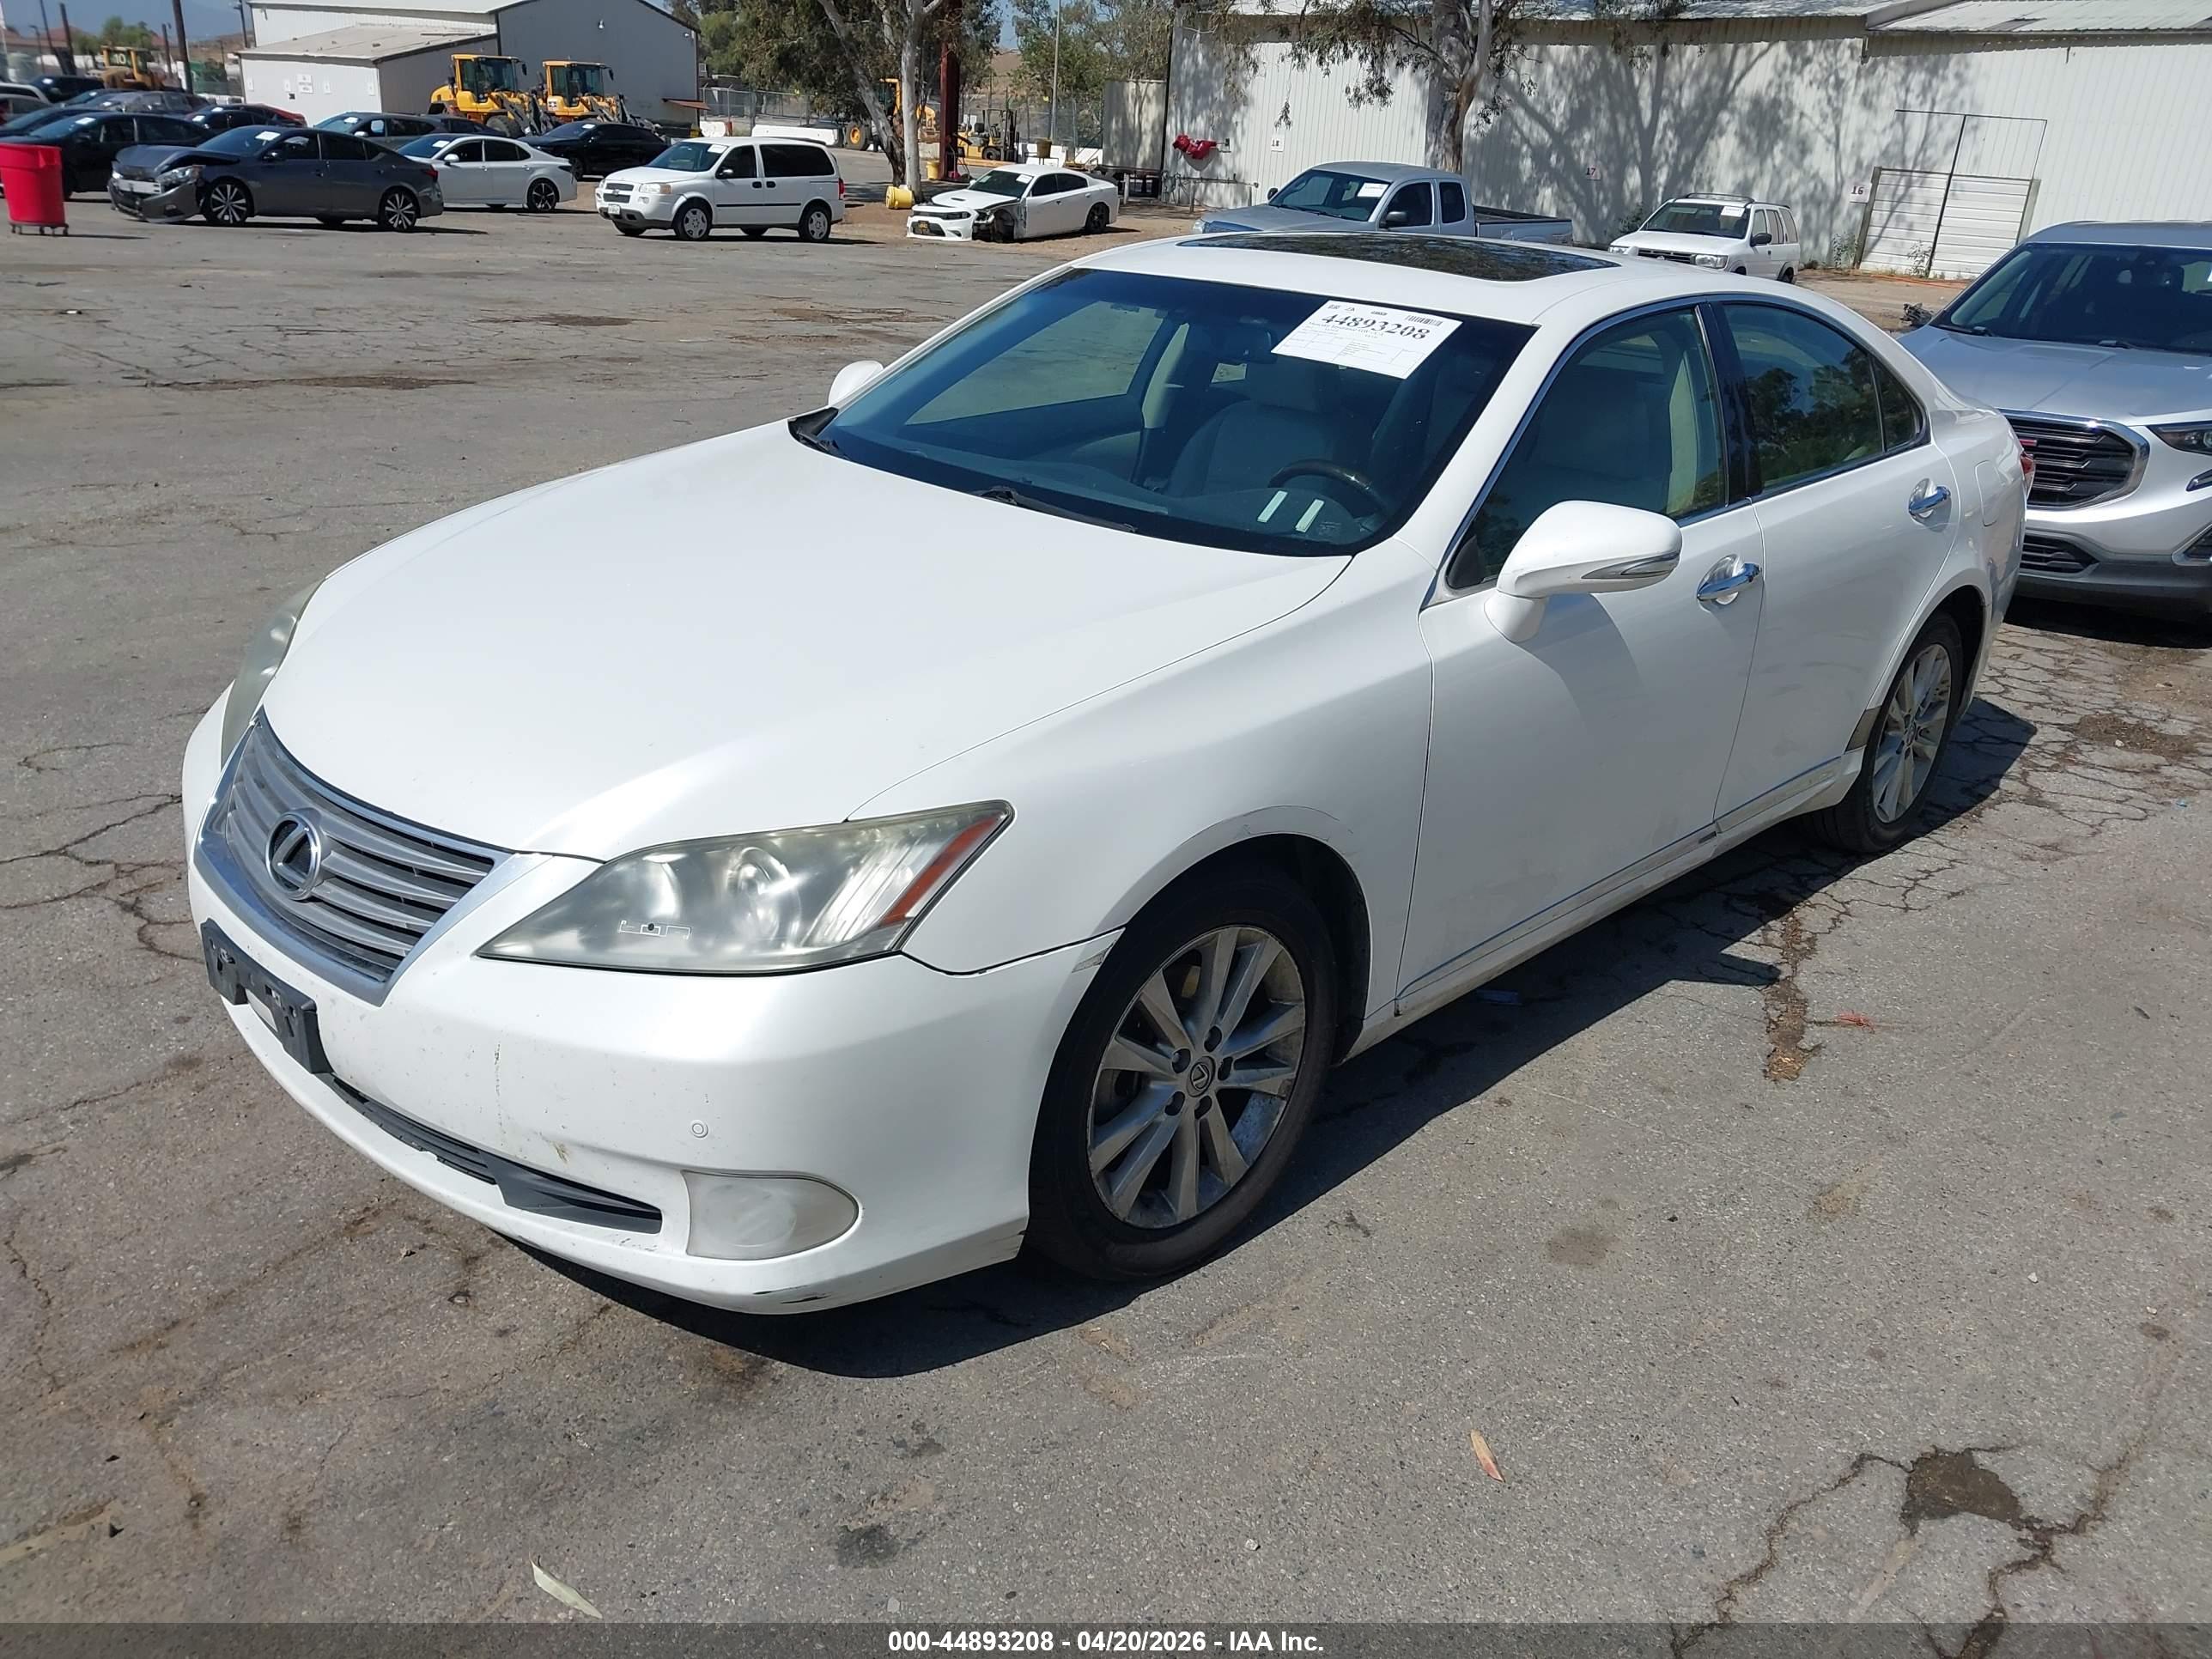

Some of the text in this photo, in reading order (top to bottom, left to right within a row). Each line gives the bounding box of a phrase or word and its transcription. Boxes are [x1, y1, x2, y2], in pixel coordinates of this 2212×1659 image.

[113, 53, 126, 64] 10
[1850, 185, 1864, 195] 16
[1321, 313, 1431, 340] 44893208
